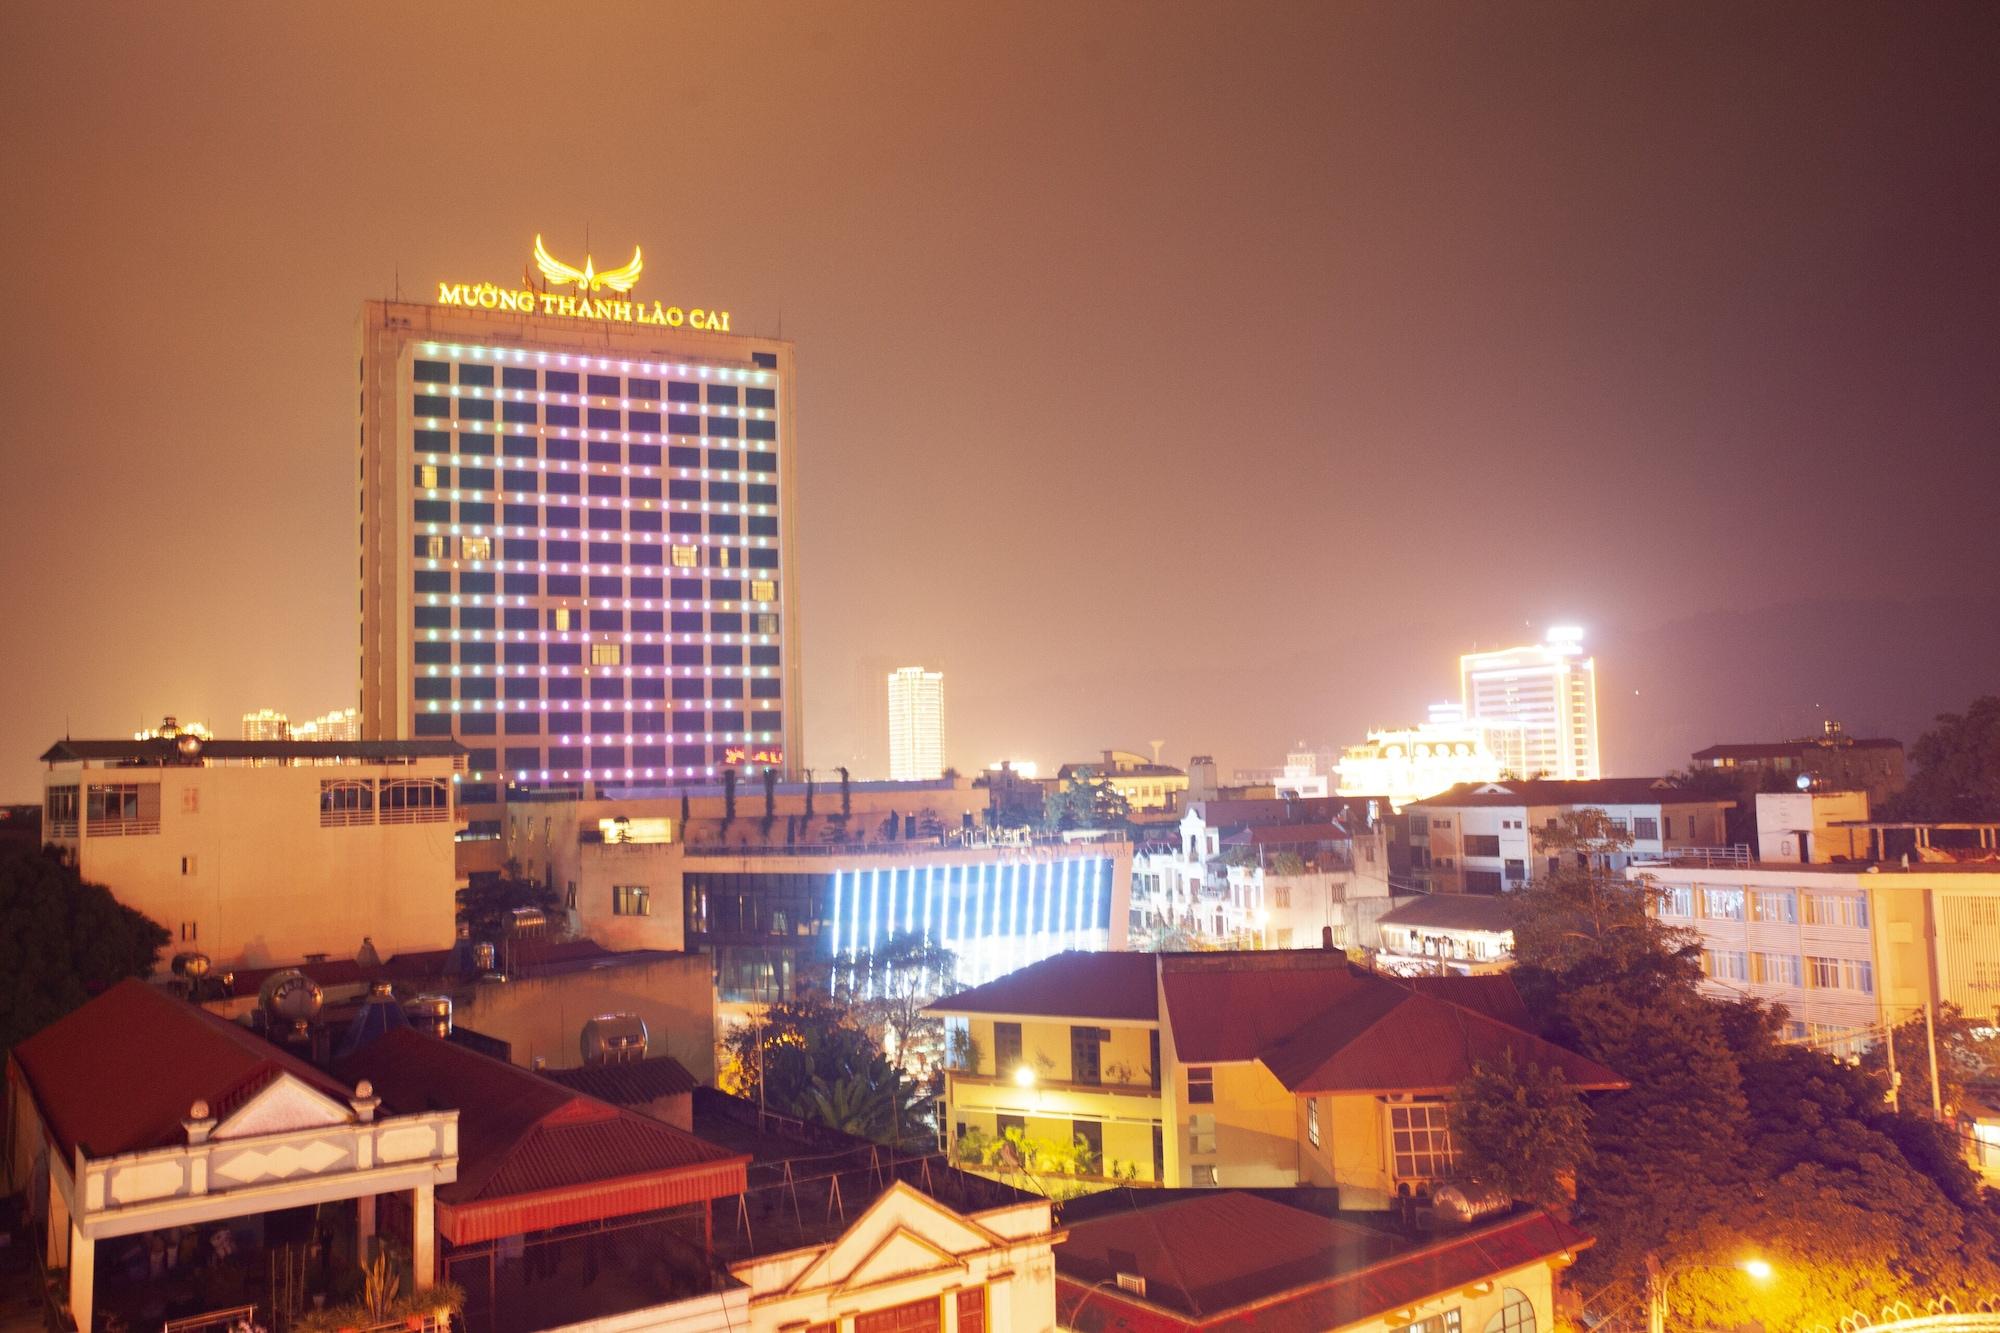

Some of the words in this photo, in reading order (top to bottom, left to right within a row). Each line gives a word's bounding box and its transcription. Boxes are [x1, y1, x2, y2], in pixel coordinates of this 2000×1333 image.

[439, 282, 535, 313] MƯỜNG
[540, 293, 632, 322] THANH
[637, 300, 684, 327] LÀO
[689, 309, 730, 332] CAI
